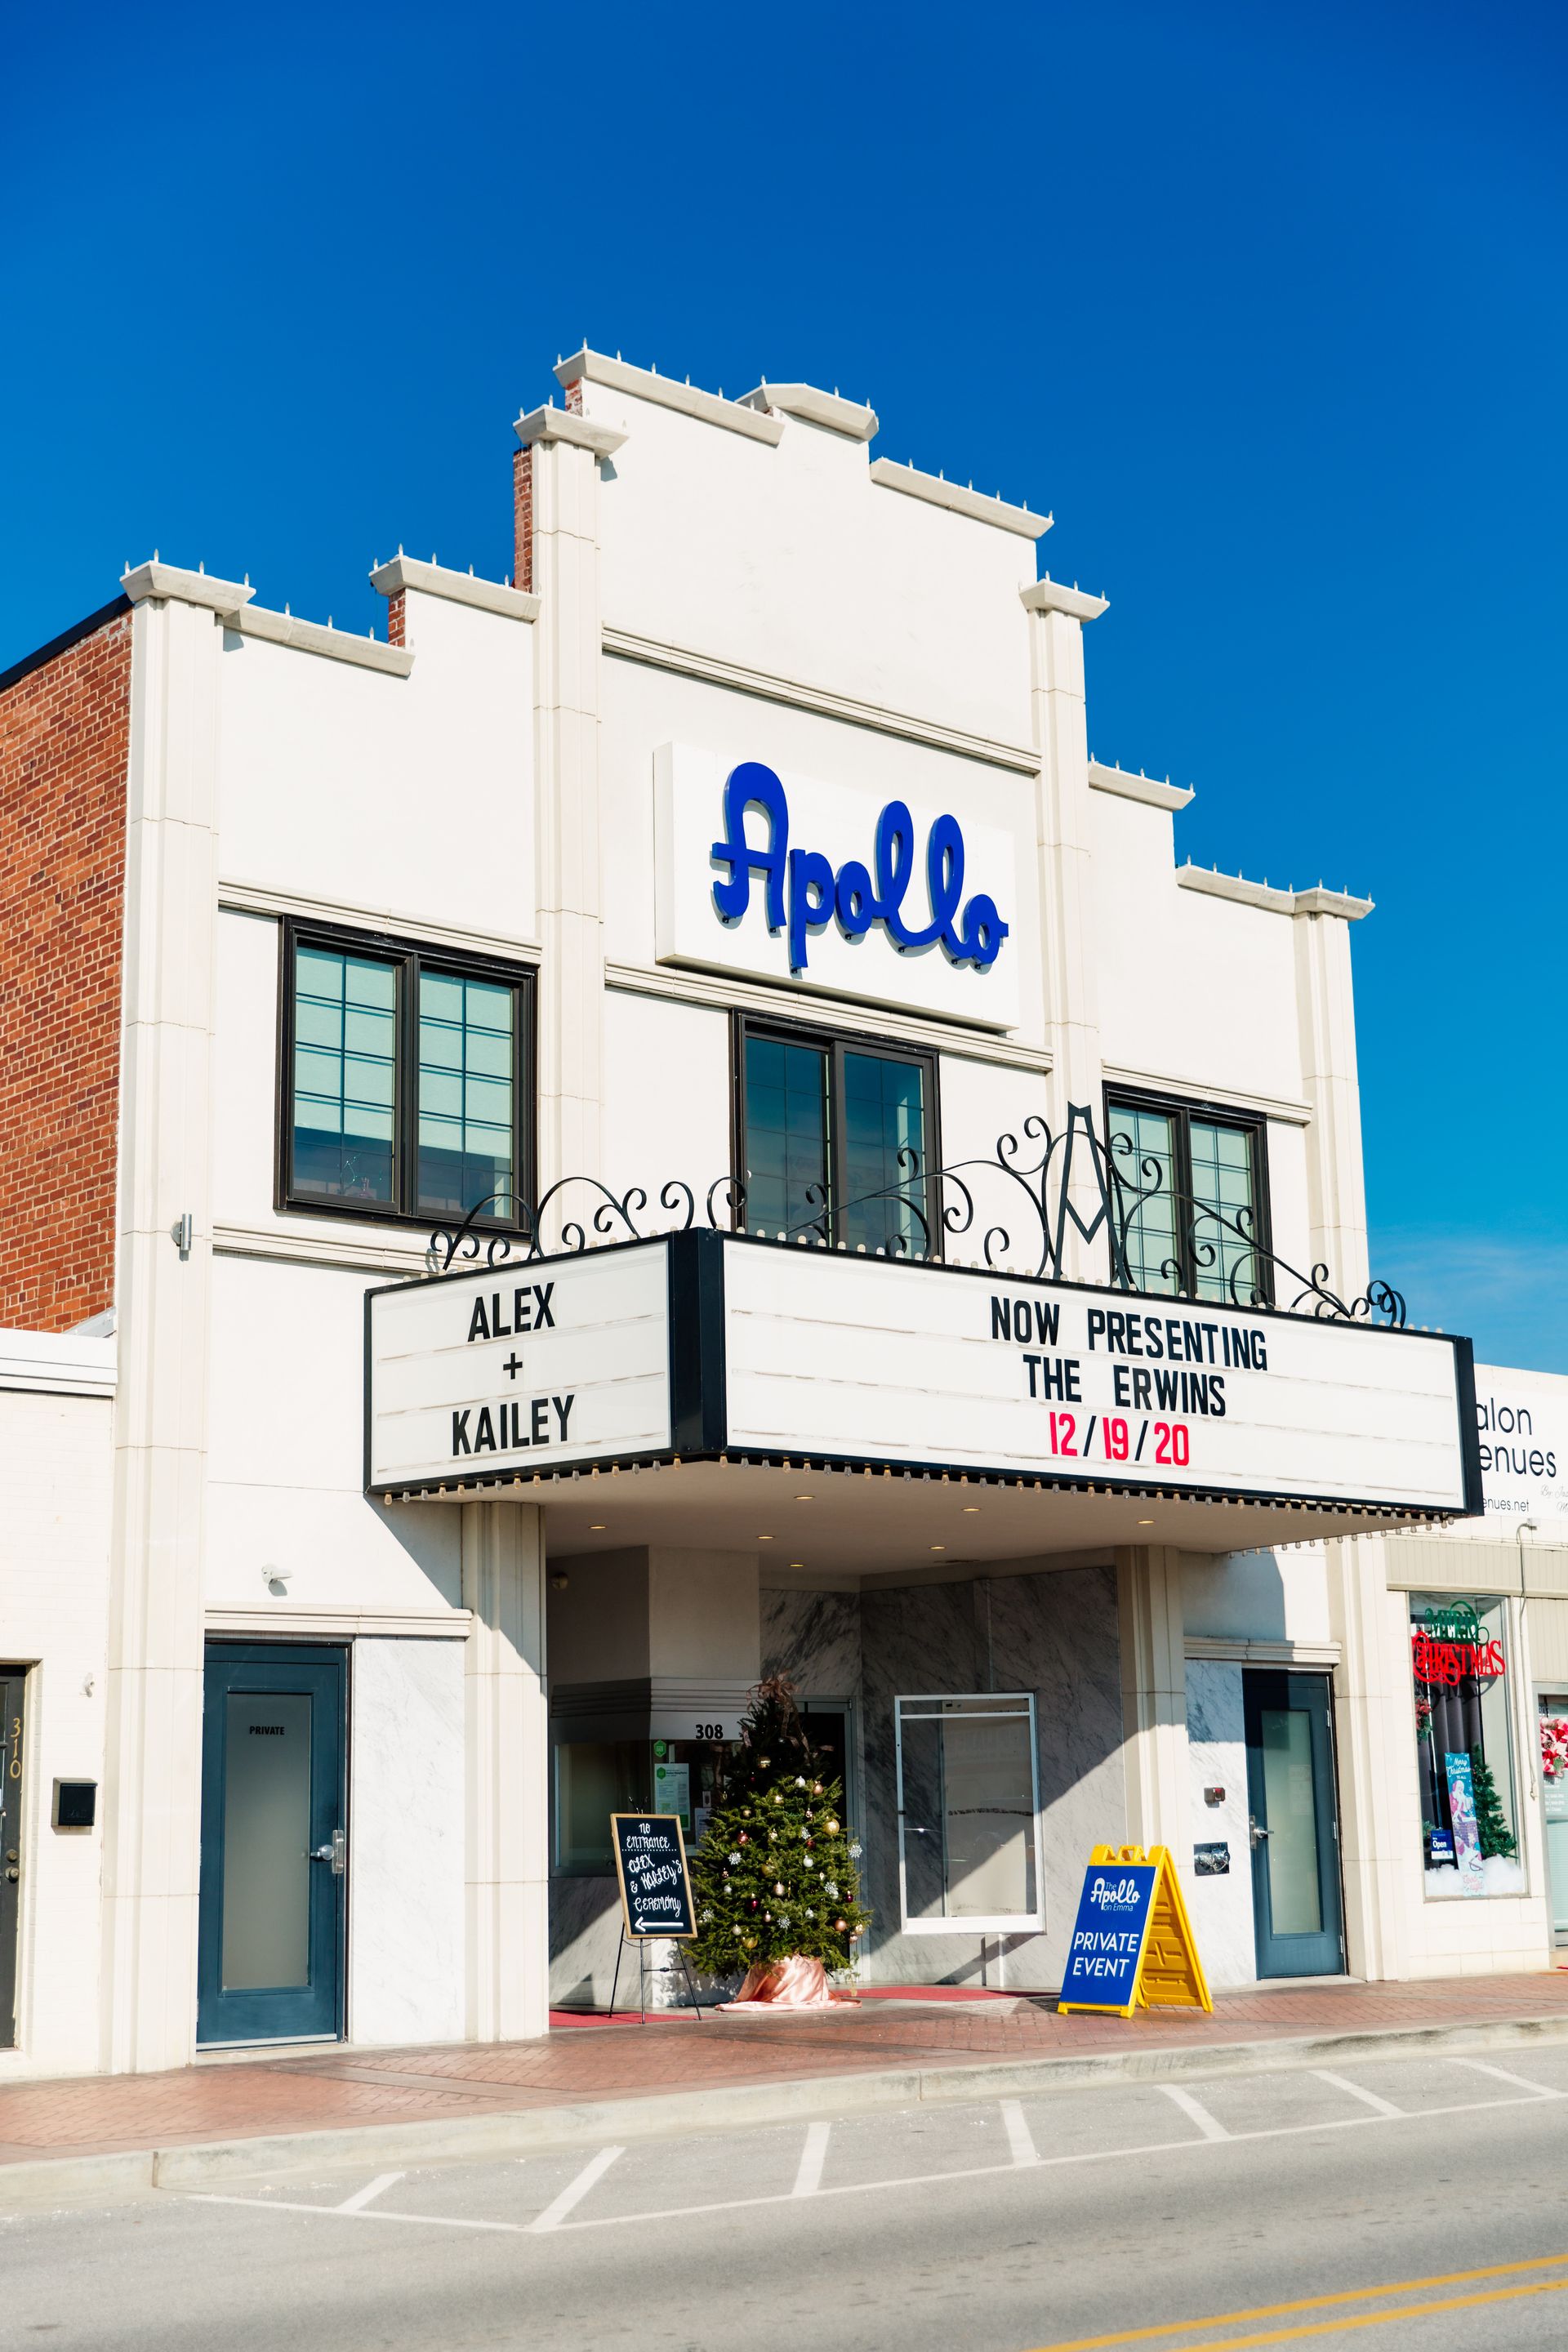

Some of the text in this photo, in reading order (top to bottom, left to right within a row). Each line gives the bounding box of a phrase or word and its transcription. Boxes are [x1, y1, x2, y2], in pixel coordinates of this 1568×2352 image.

[711, 761, 1009, 969] Apollo
[467, 1281, 556, 1343] ALEX
[991, 1295, 1268, 1371] NOW PRESENTING
[502, 1352, 523, 1380] +
[1022, 1353, 1226, 1417] THE ERWINS
[452, 1393, 576, 1456] KAILEY
[1476, 1396, 1533, 1436] alon
[1049, 1410, 1190, 1467] 12/19/20
[1478, 1443, 1557, 1478] enues
[1482, 1497, 1530, 1512] enues.net
[1411, 1630, 1506, 1686] CHRISTMAS
[249, 1725, 286, 1736] PRIVATE
[695, 1724, 724, 1740] 308
[10, 1717, 21, 1779] 310
[1432, 1840, 1447, 1850] Open
[630, 1880, 639, 1894] &
[1090, 1878, 1141, 1910] Apollo
[1105, 1882, 1117, 1891] The
[1112, 1903, 1134, 1912] Emma
[1073, 1931, 1140, 1953] PRIVATE
[1072, 1957, 1130, 1978] EVENT
